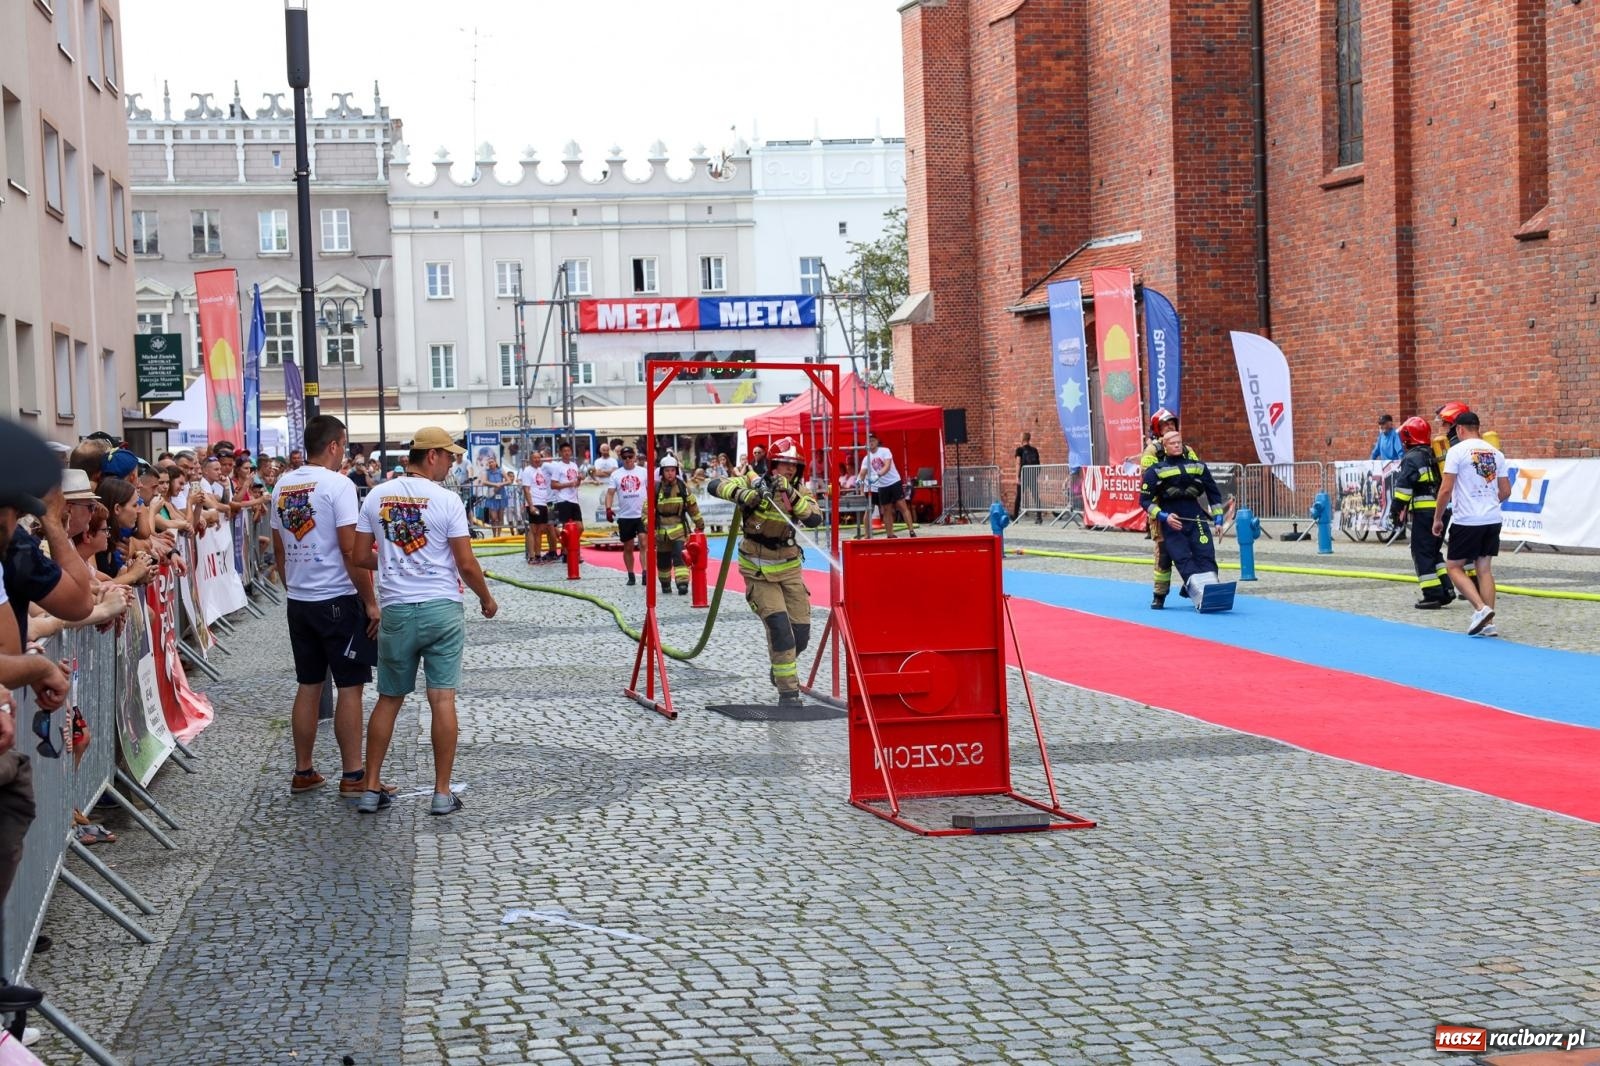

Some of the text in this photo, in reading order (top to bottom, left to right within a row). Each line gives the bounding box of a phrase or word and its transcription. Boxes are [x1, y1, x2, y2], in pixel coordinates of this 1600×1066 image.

[597, 303, 681, 330] META
[719, 300, 802, 327] META
[1103, 478, 1141, 492] RESCUE
